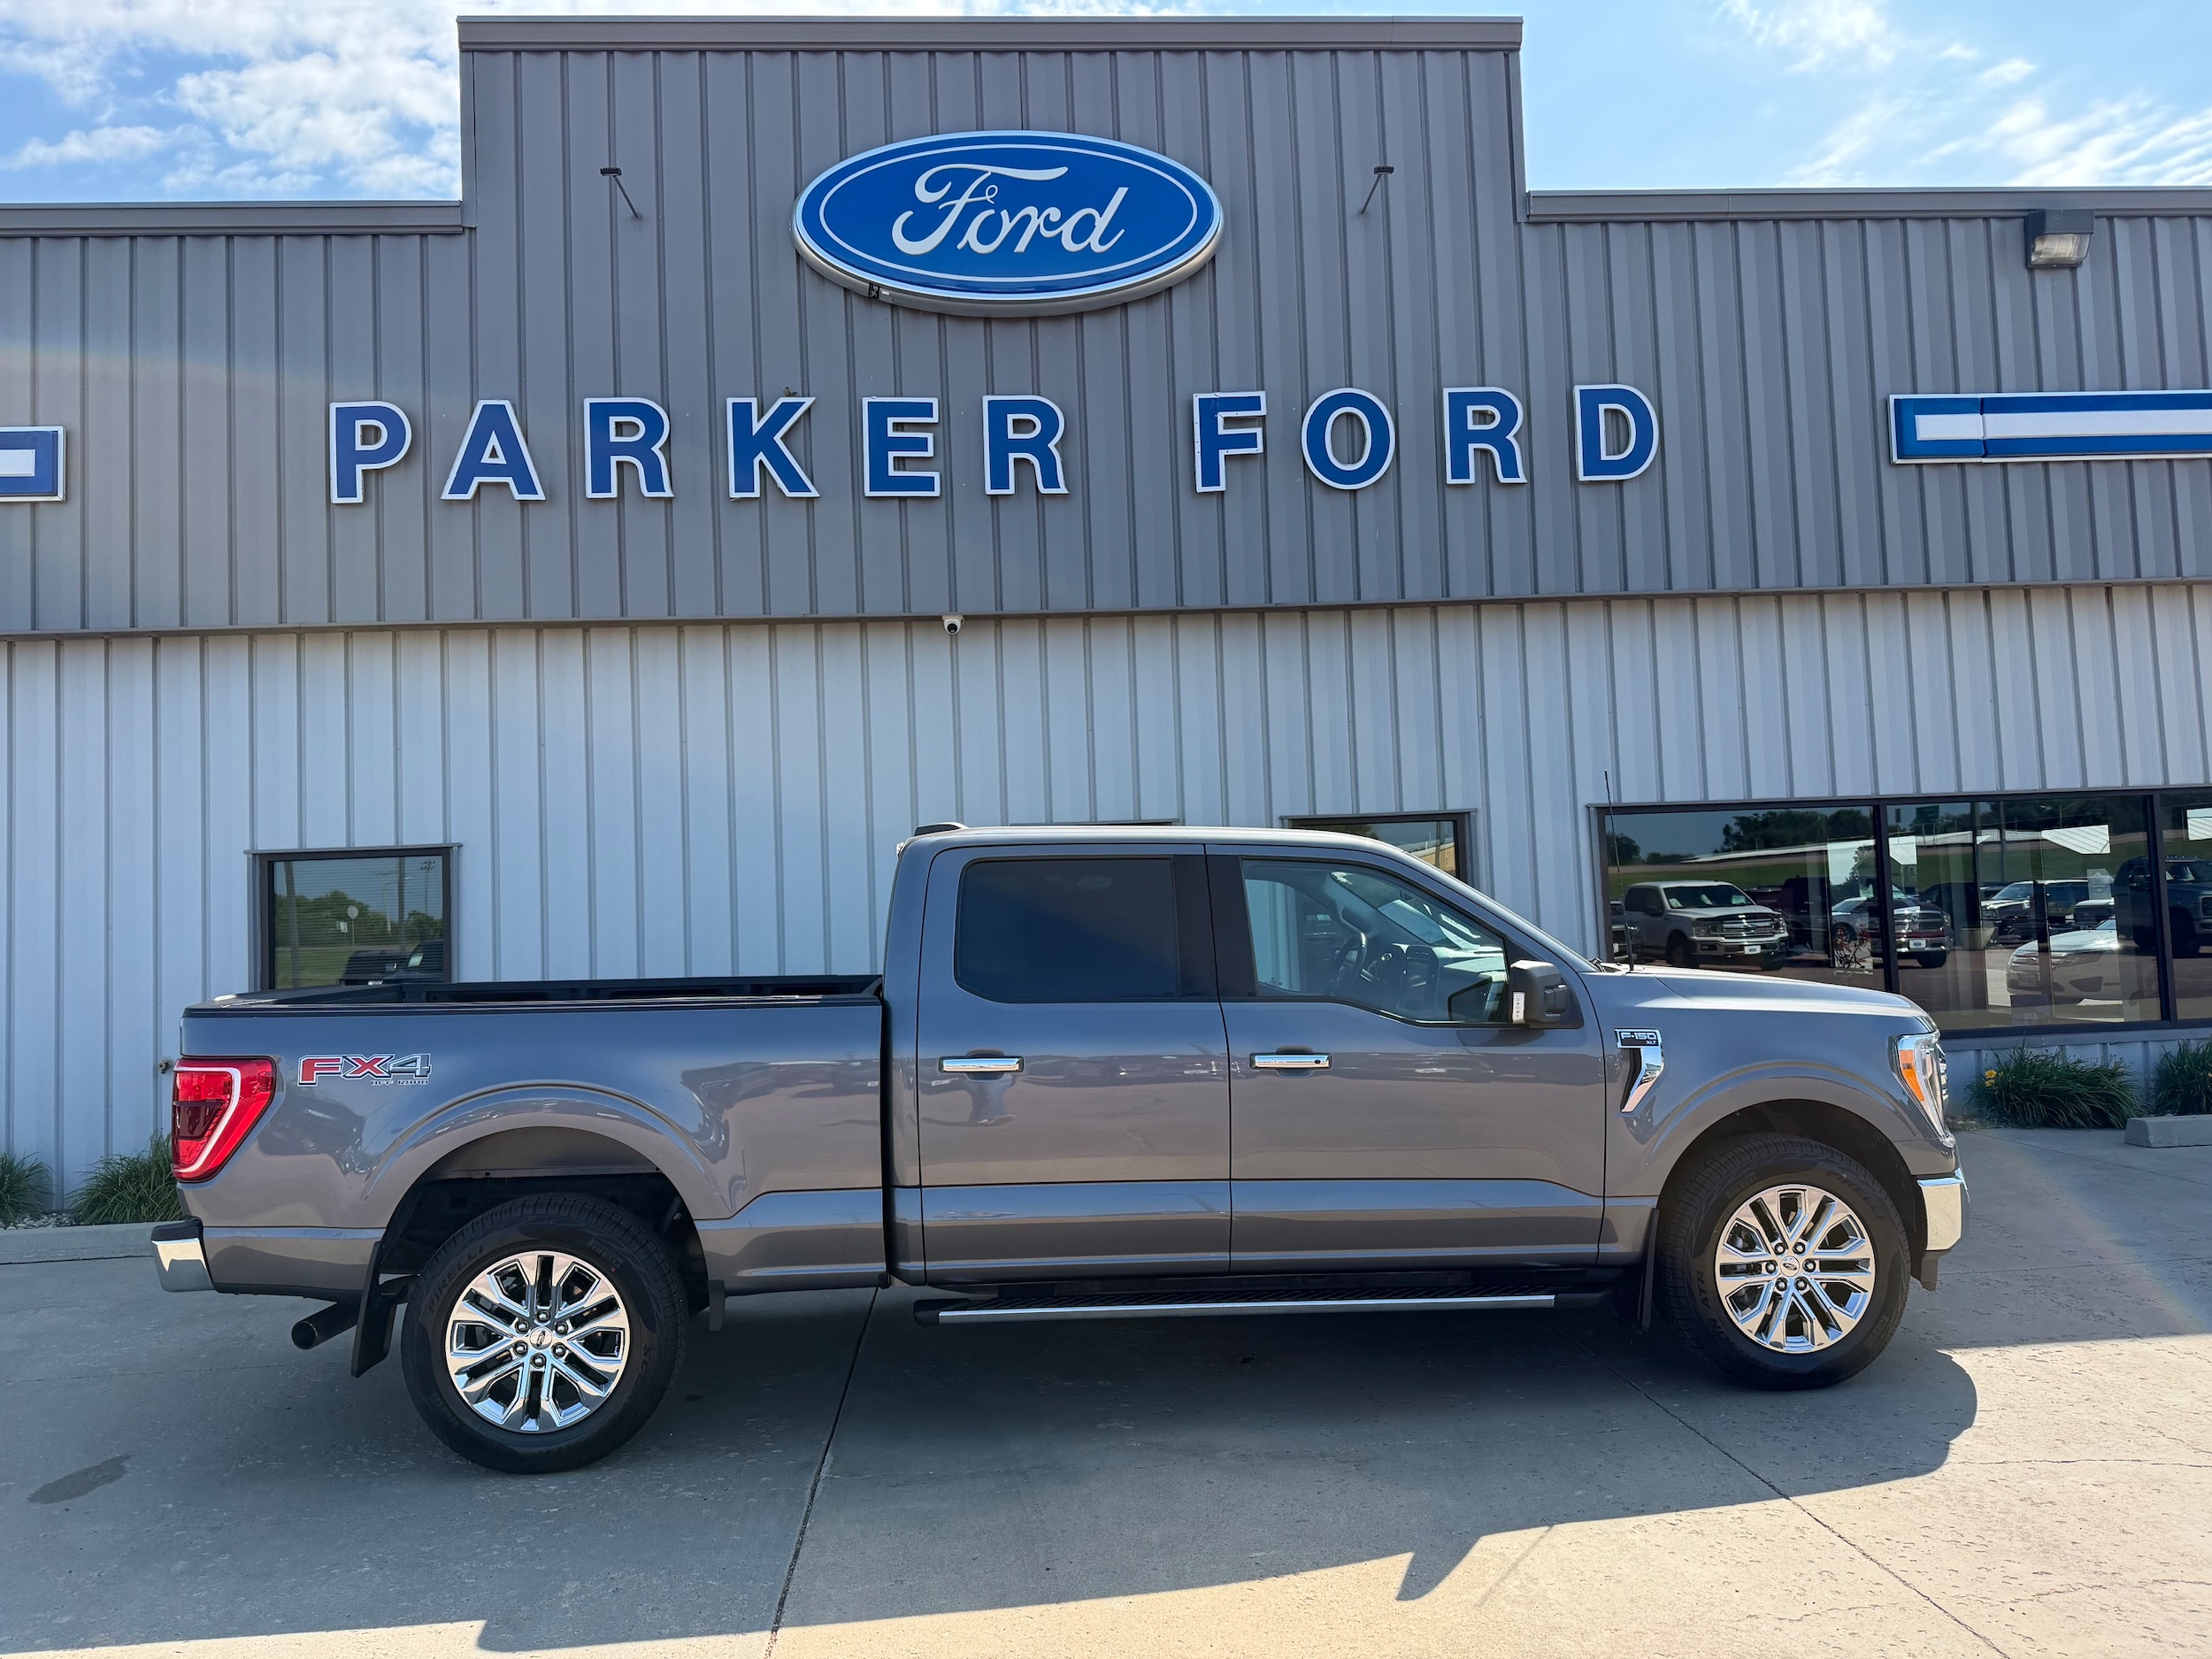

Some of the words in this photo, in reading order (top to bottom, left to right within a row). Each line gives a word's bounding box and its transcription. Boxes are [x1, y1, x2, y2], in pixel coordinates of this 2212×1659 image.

[891, 163, 1129, 256] Ford
[328, 395, 1071, 504] PARKER
[1192, 383, 1660, 494] FORD
[297, 1053, 432, 1087] FX4
[426, 1244, 484, 1315] PIRELLI
